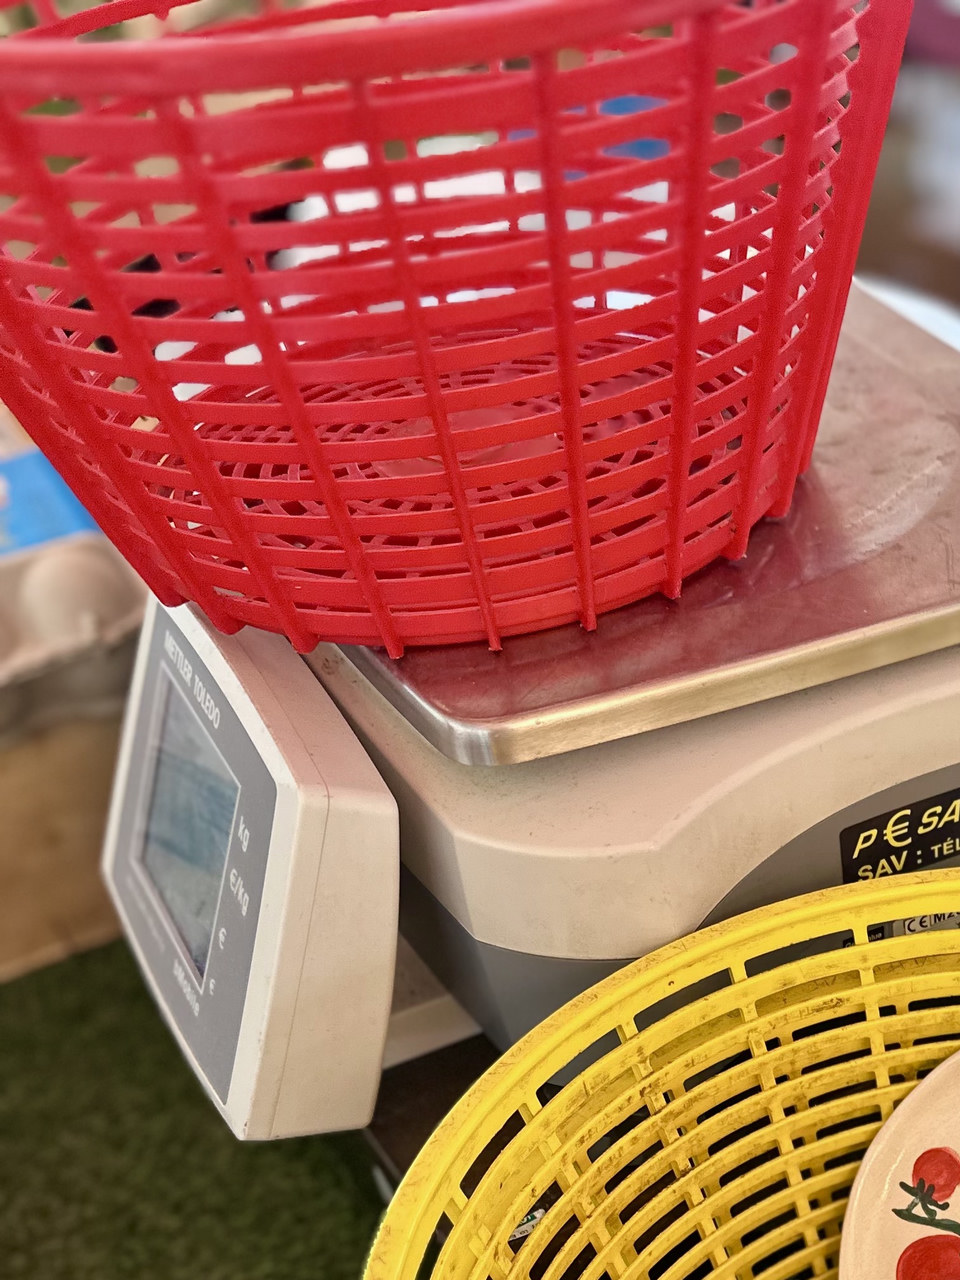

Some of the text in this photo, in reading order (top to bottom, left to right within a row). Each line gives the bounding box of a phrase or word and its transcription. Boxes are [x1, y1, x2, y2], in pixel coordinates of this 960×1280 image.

[194, 674, 221, 729] TOLEDO
[237, 815, 250, 852] kg
[857, 850, 908, 882] SAV
